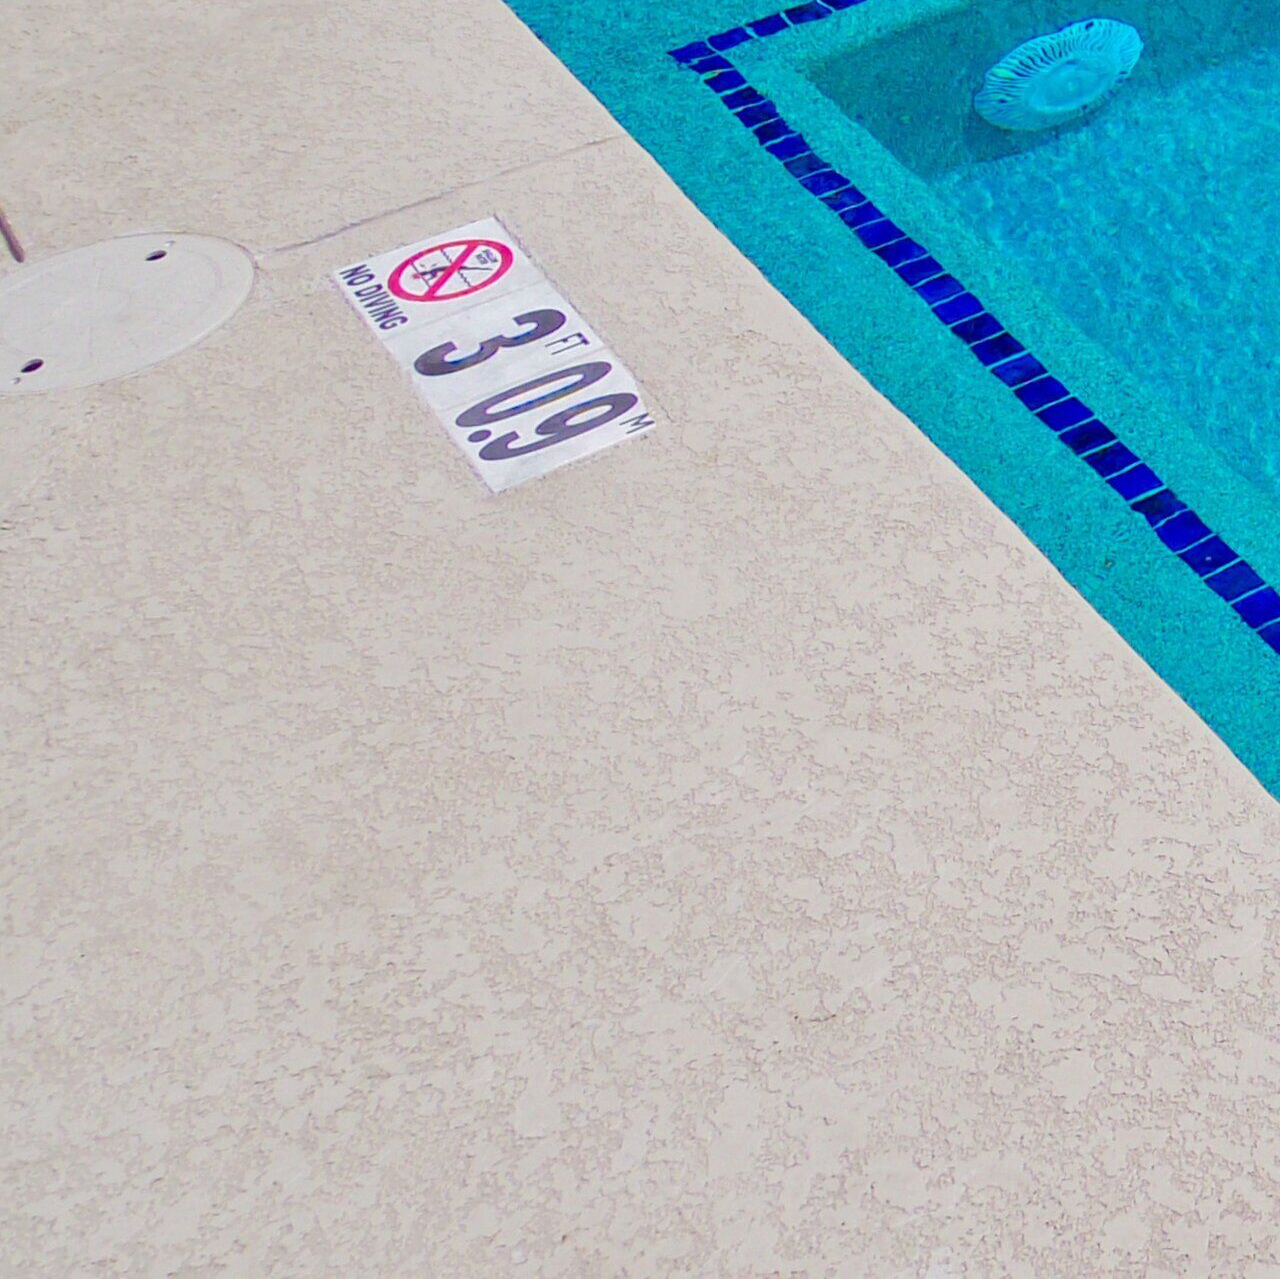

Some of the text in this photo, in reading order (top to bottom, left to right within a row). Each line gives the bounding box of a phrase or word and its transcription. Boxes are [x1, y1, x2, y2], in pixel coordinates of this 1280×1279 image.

[339, 263, 409, 330] NO DIVING
[413, 308, 656, 461] 3 FT 0.9 M
